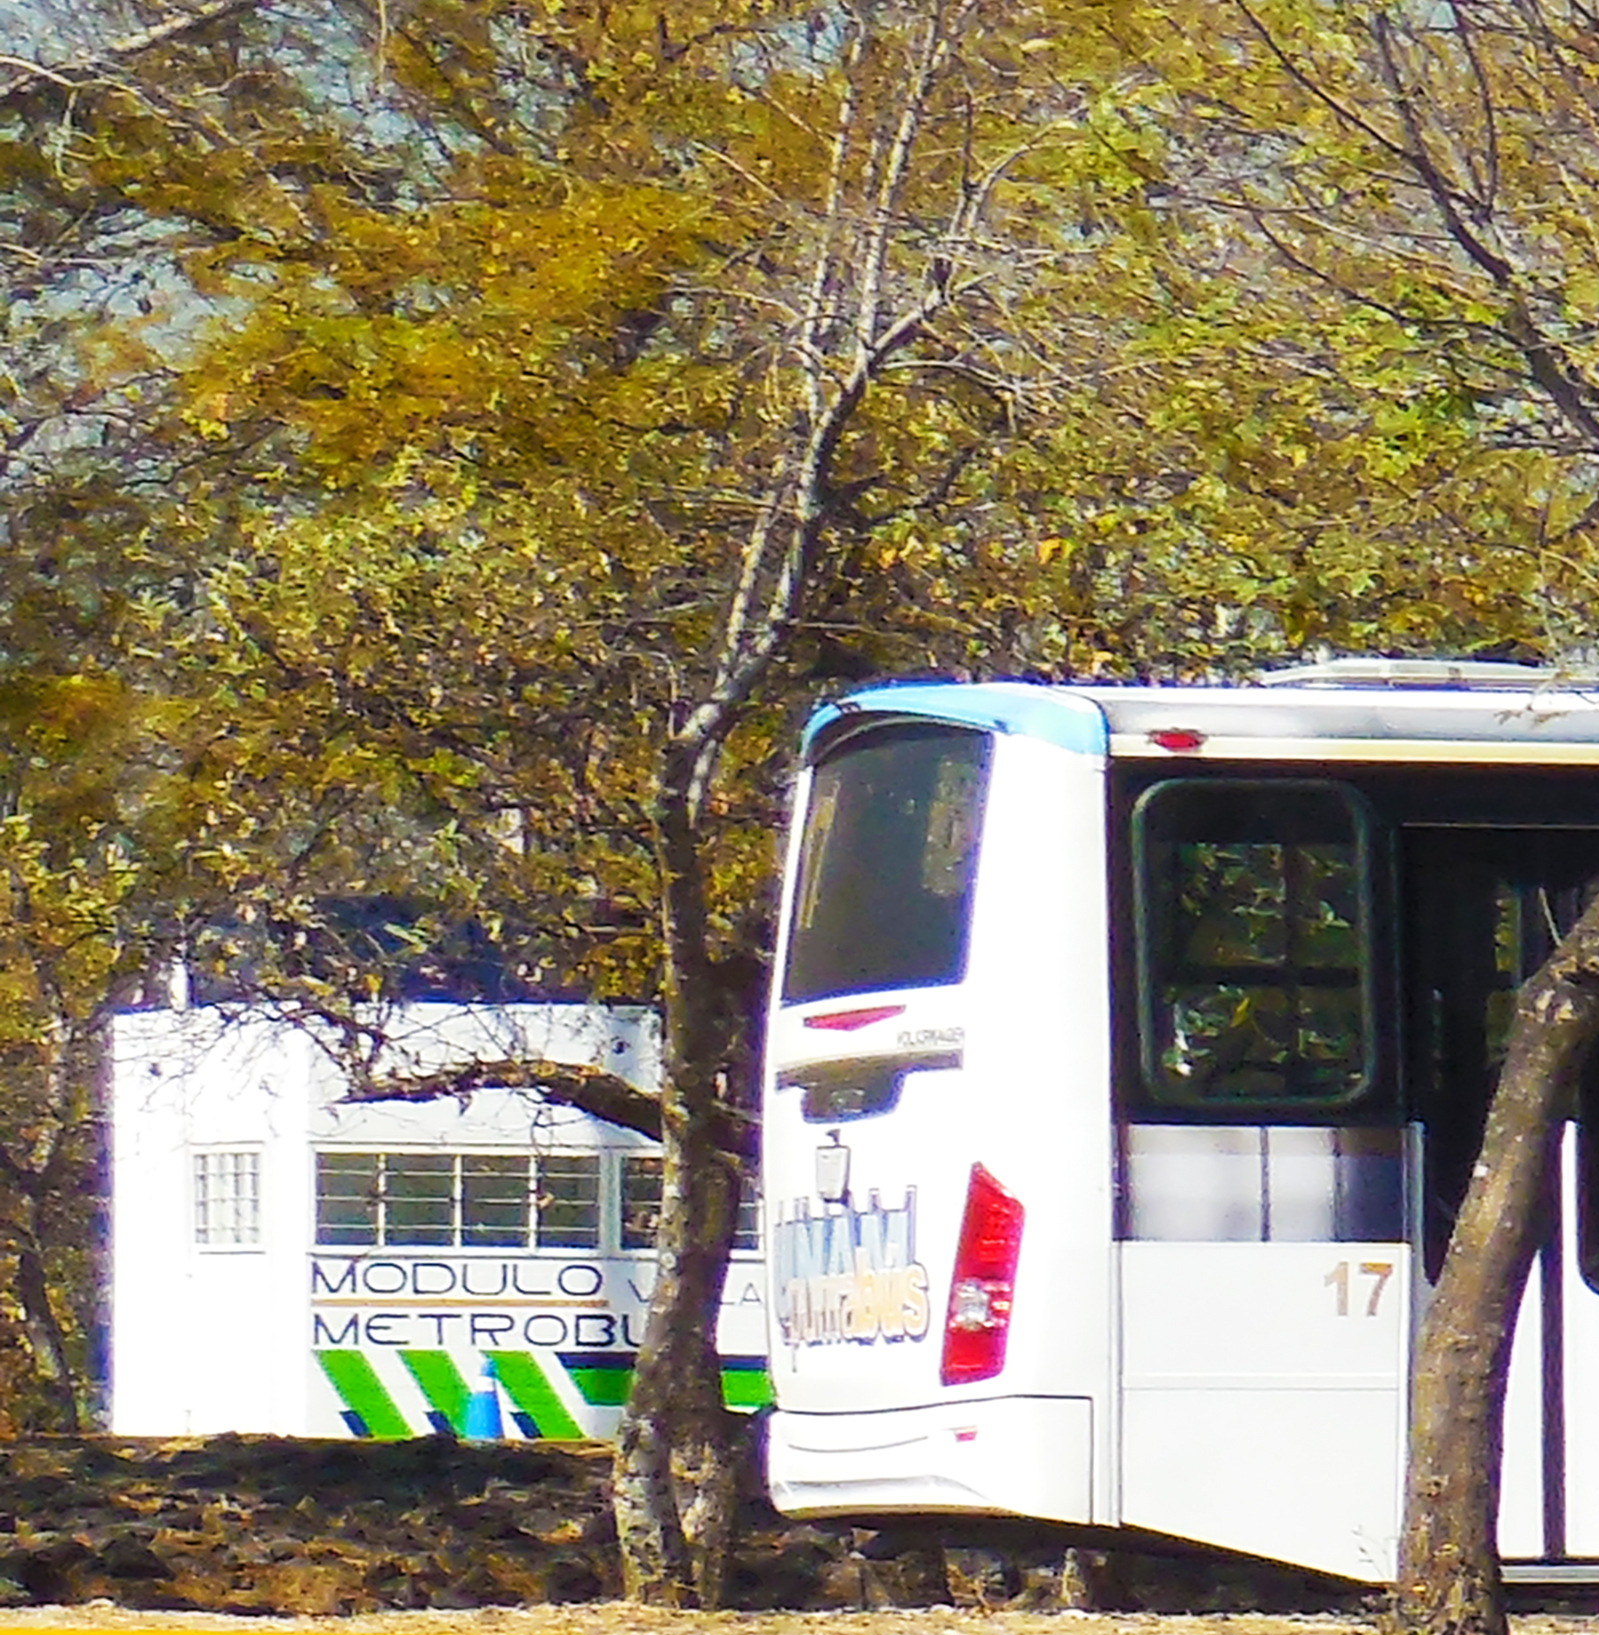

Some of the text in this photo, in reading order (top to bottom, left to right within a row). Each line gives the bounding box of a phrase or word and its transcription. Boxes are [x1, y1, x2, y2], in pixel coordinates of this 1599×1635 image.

[312, 1262, 603, 1296] MODULO
[1323, 1261, 1393, 1317] 17
[313, 1312, 646, 1345] METROBU
